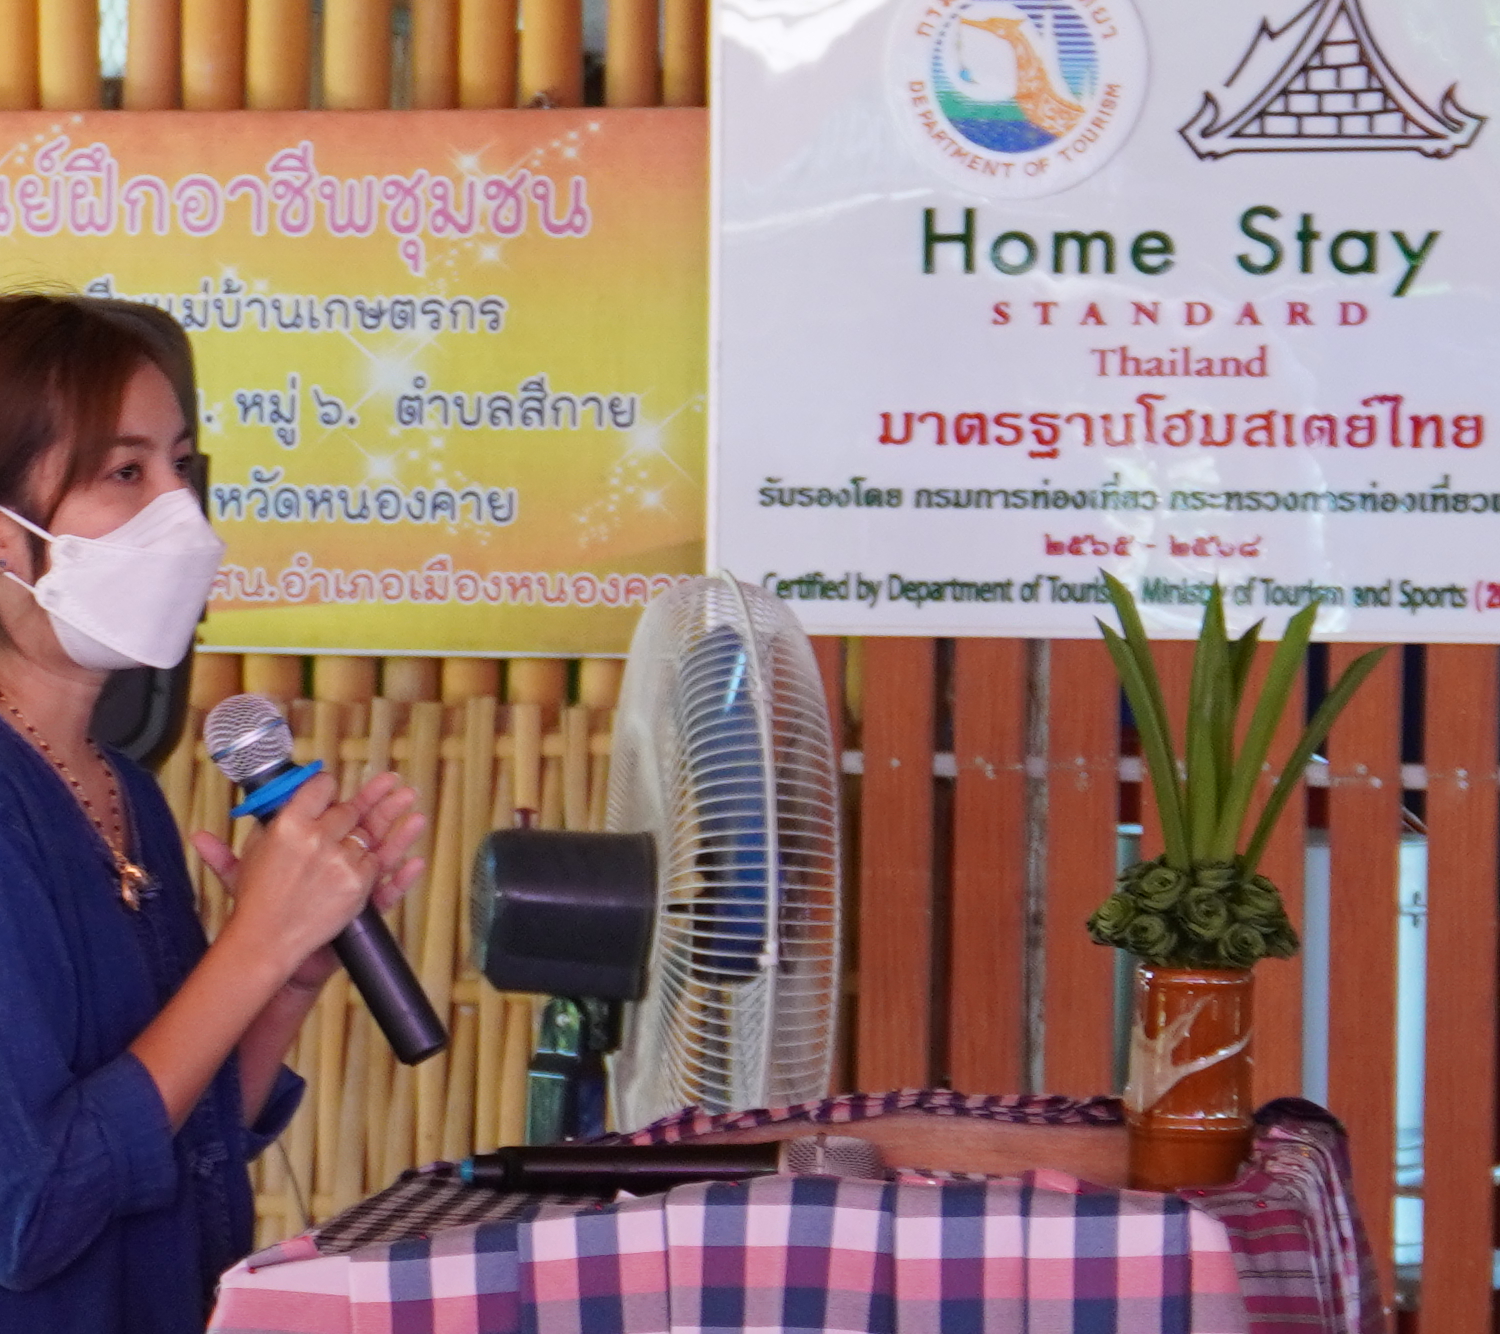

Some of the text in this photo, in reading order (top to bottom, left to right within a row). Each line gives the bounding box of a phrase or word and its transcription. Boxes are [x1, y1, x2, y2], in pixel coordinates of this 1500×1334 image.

[908, 79, 1121, 178] DEPARTMENT OF TOURISM
[920, 205, 1442, 298] Home Stay
[990, 301, 1370, 328] STANDARD
[1090, 347, 1270, 380] Thailand
[236, 373, 298, 445] หมู่
[398, 375, 638, 431] ตำบลสีกาย
[877, 395, 1487, 459] มาตรฐานโฮมสเตย์ไทย
[763, 573, 852, 603] Certified
[854, 573, 883, 608] by
[887, 574, 1014, 608] Department
[1020, 573, 1045, 604] of
[1046, 576, 1112, 603] Touris
[1234, 577, 1256, 605] of
[1352, 579, 1395, 608] and
[1399, 581, 1468, 614] Sports
